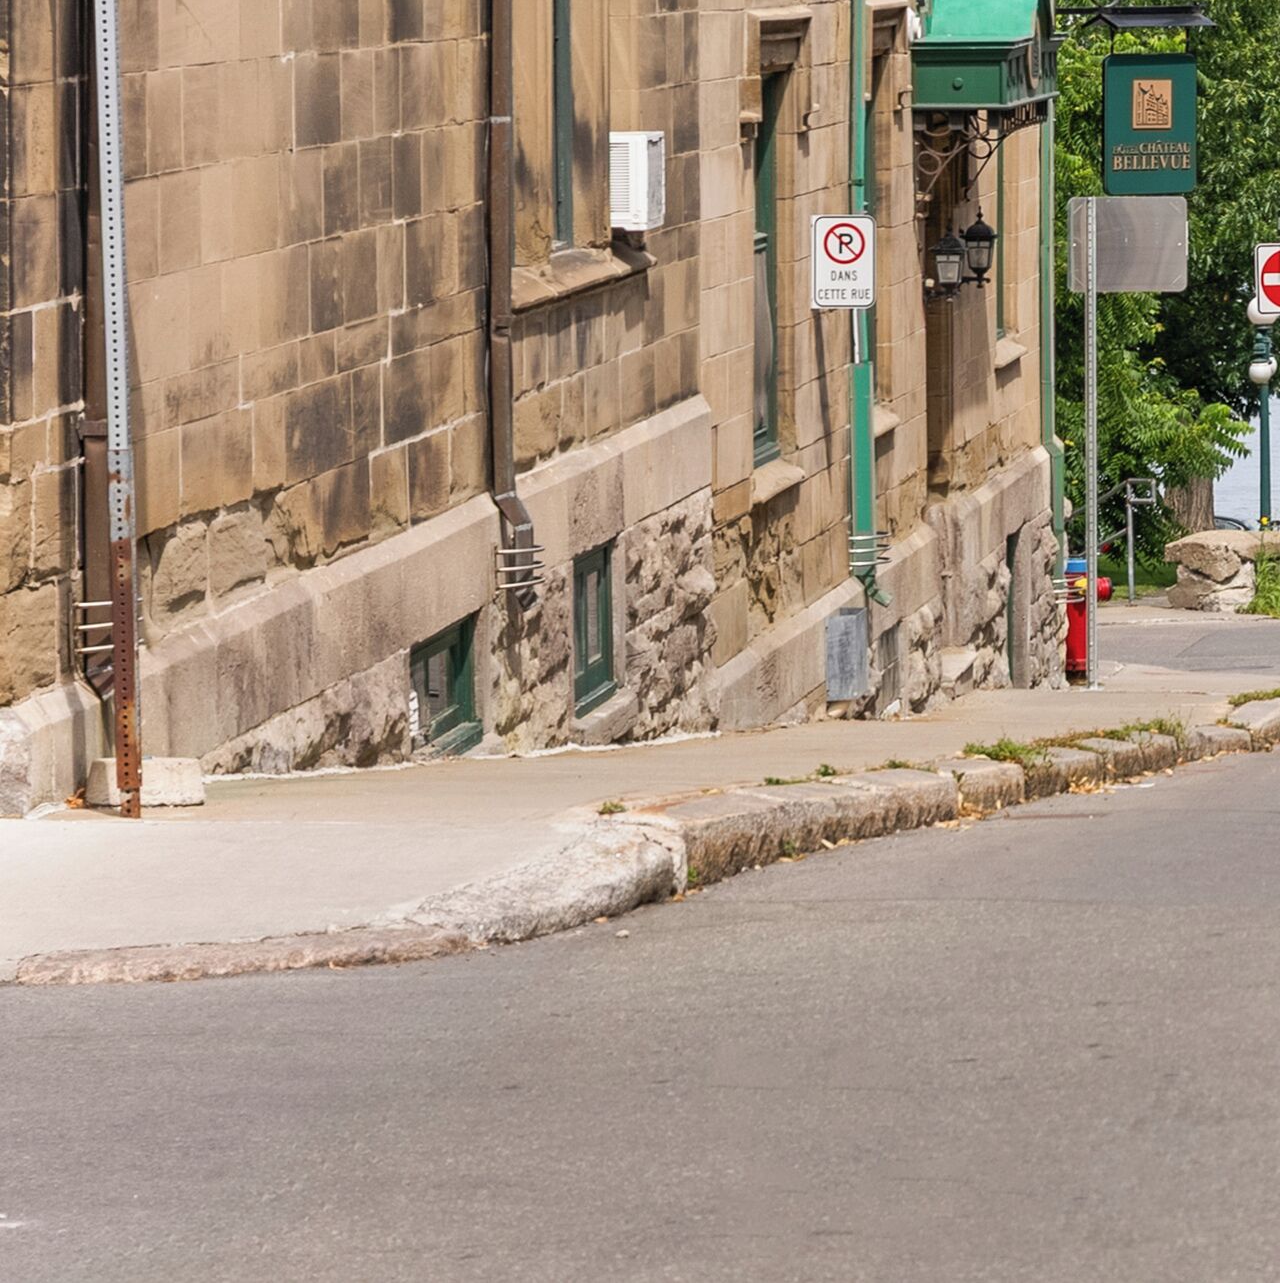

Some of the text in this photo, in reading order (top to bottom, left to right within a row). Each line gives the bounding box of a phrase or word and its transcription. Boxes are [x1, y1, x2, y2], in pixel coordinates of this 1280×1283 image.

[1139, 140, 1191, 154] CHÂTEAU
[1112, 154, 1191, 171] BELLEVUE
[830, 270, 858, 281] DANS
[817, 288, 871, 300] CETTE RUE
